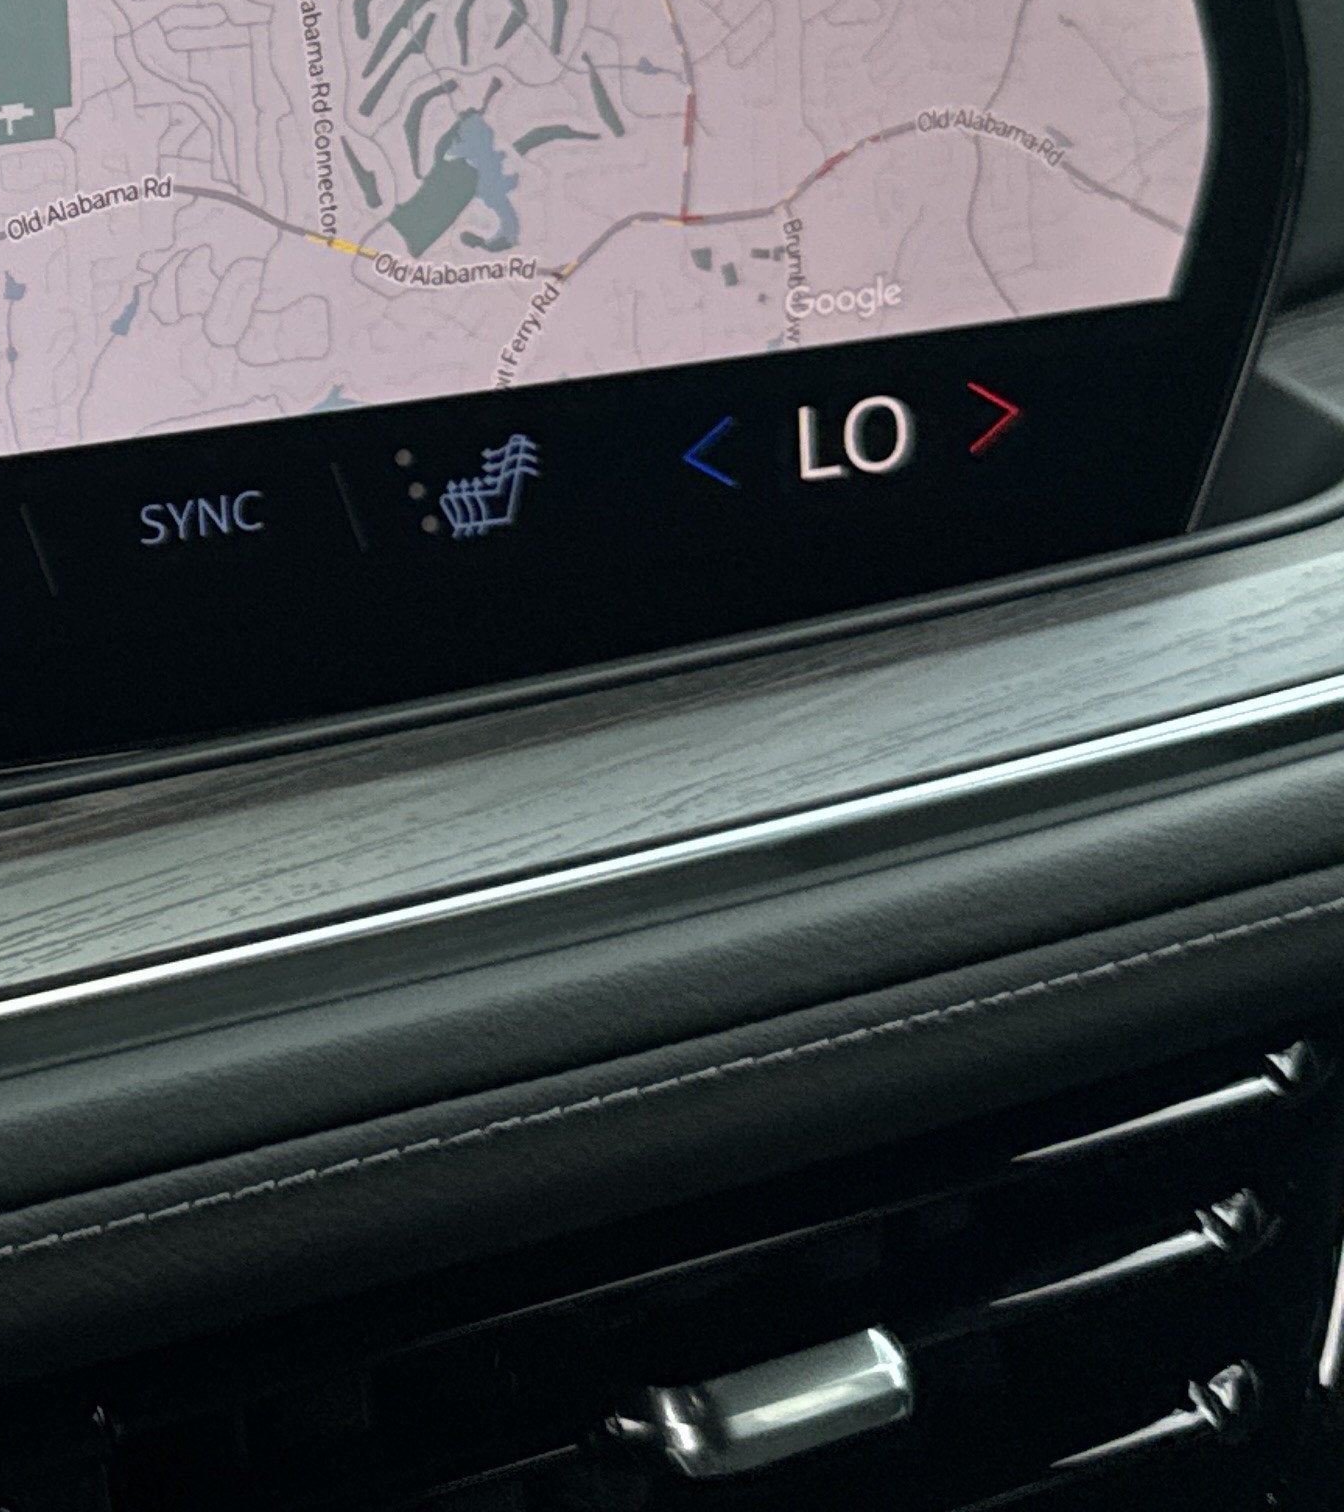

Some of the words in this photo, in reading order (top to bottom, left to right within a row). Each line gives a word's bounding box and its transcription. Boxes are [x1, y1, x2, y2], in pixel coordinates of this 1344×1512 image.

[311, 81, 333, 114] Rd
[917, 109, 950, 132] Old
[953, 108, 1038, 150] Alabama
[1037, 138, 1065, 167] Rd
[312, 116, 338, 236] Connector
[7, 215, 43, 241] Old
[48, 184, 139, 224] Alabama
[144, 178, 172, 200] Rd
[374, 253, 411, 281] Old
[413, 263, 505, 285] Alabama
[510, 259, 536, 280] Rd
[784, 219, 804, 344] Brumbw
[501, 313, 542, 366] Ferry
[531, 281, 561, 314] Rd
[785, 274, 902, 328] Google
[798, 395, 911, 481] LO
[139, 489, 266, 546] SYNC
